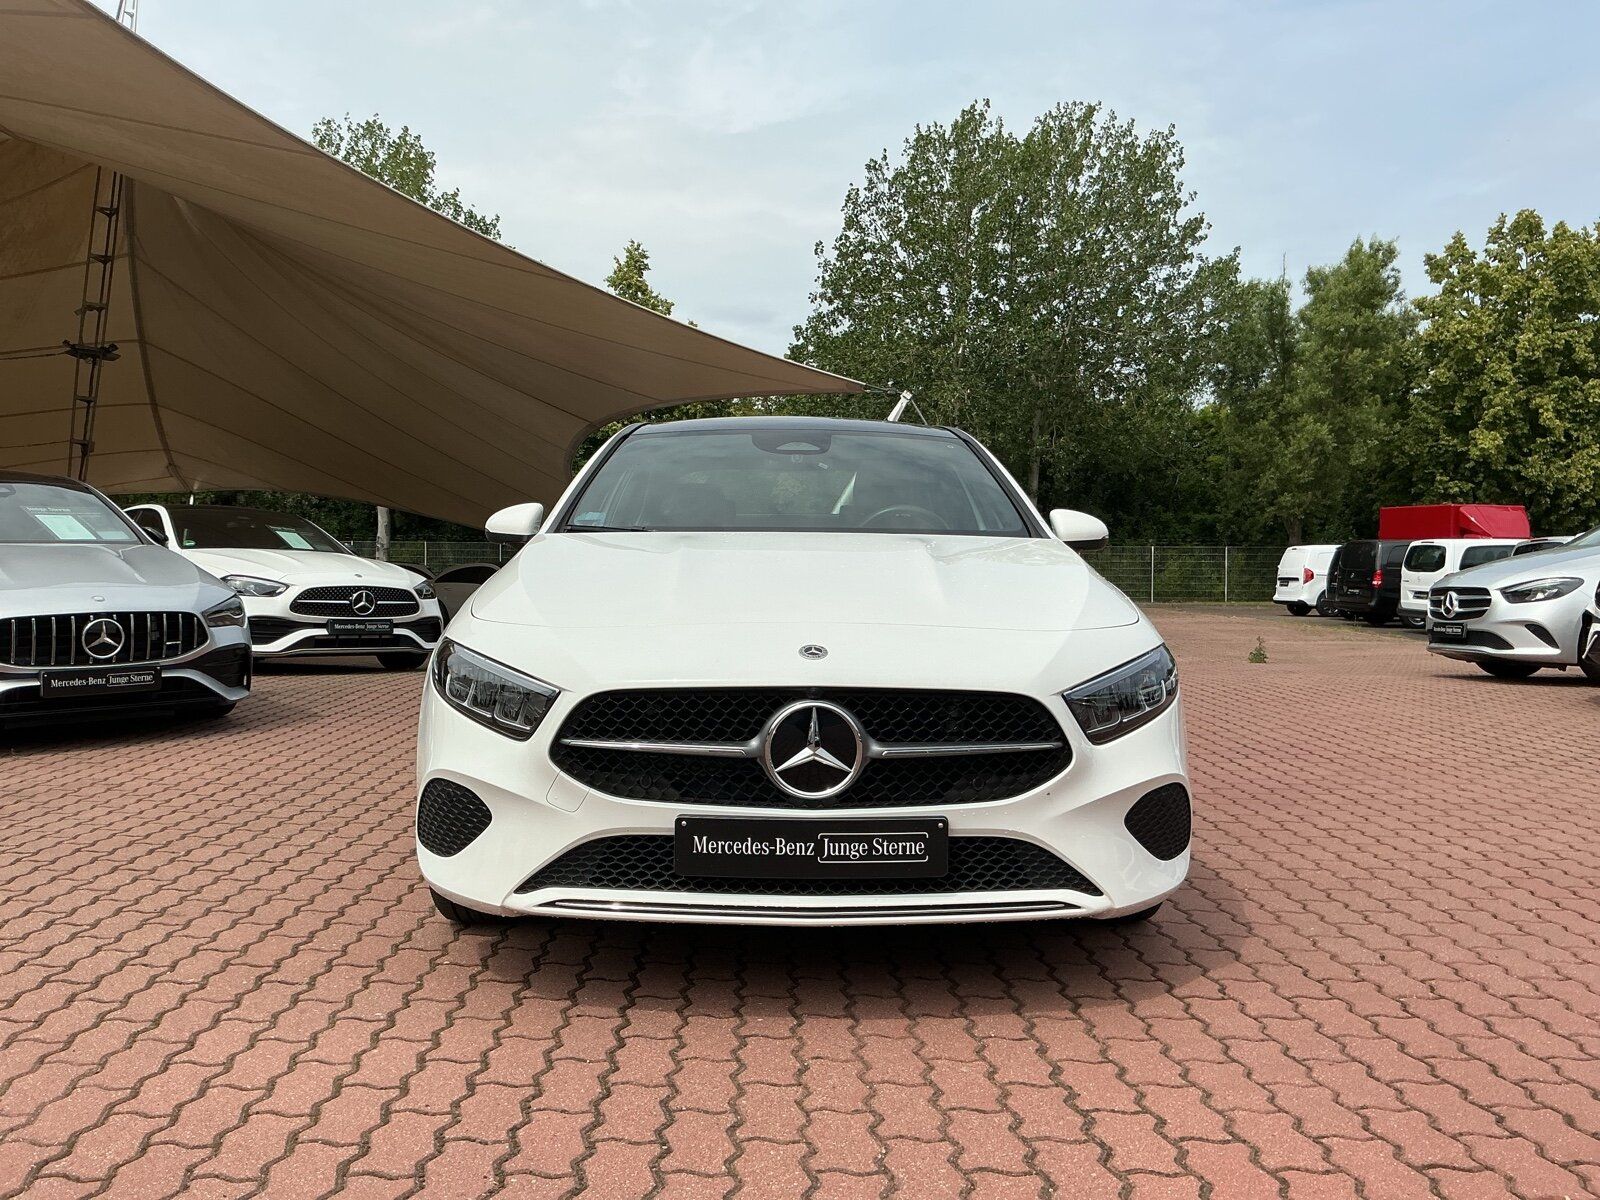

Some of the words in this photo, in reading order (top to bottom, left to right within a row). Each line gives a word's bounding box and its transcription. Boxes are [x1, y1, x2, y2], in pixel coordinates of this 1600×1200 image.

[50, 677, 106, 688] Mercedes-Benz
[109, 675, 129, 685] Junge
[130, 674, 153, 682] Sterne
[692, 835, 815, 856] Mercedes-Benz
[822, 838, 868, 860] Junge
[872, 838, 925, 856] Sterne
